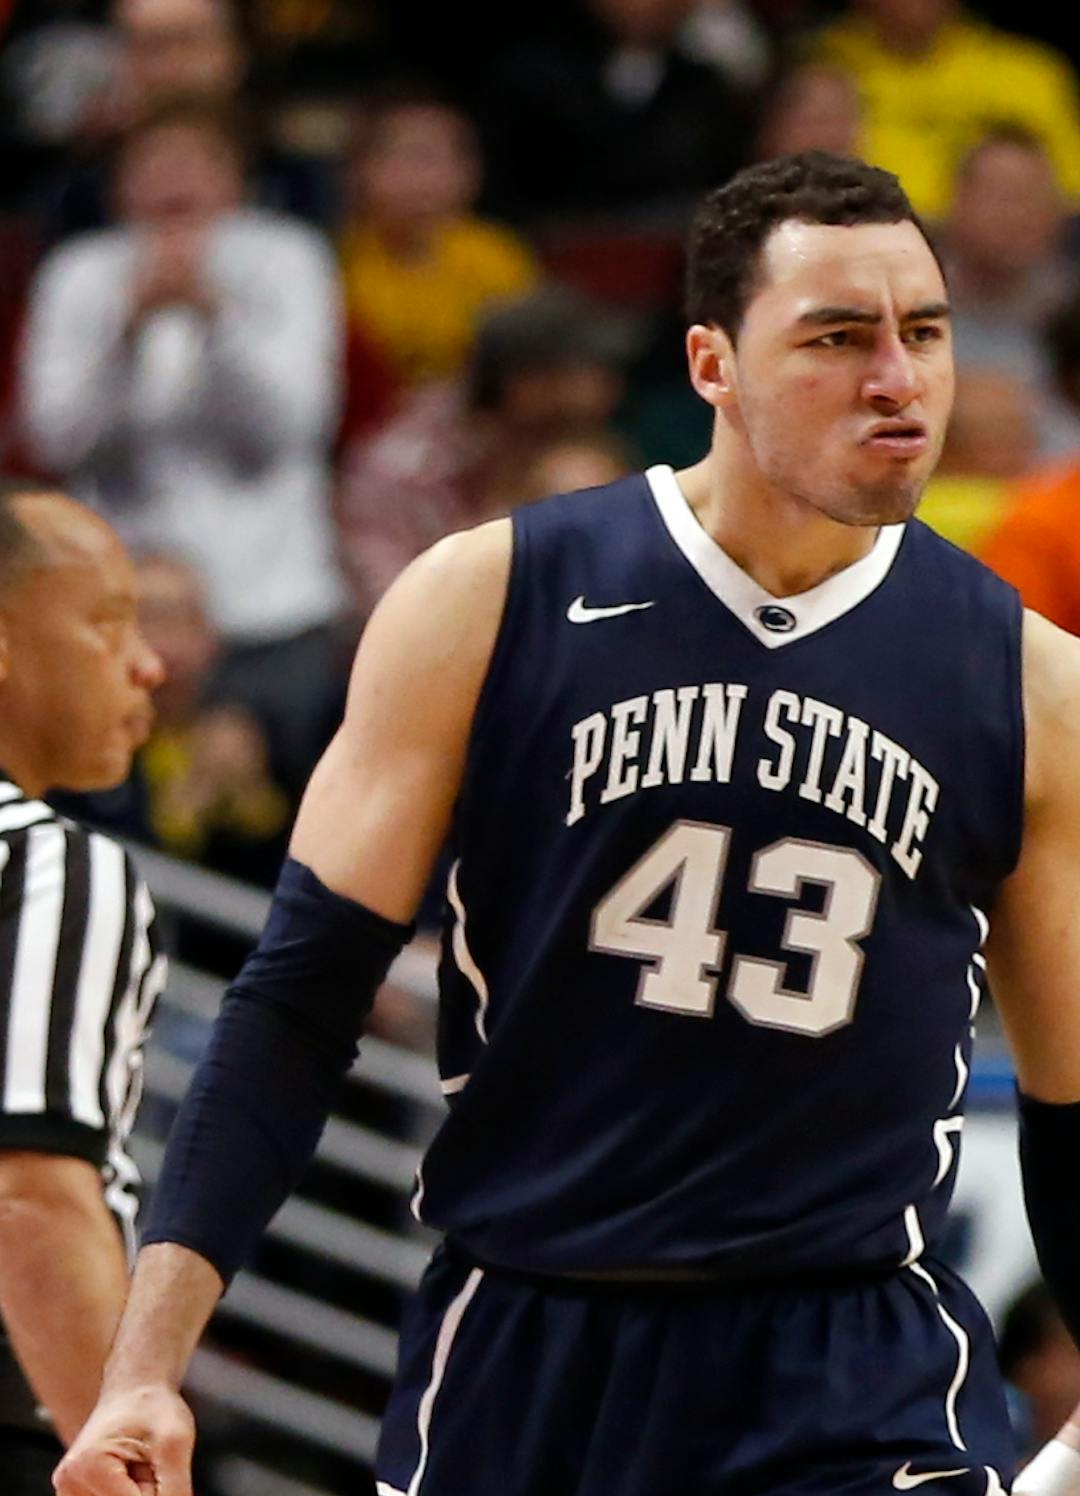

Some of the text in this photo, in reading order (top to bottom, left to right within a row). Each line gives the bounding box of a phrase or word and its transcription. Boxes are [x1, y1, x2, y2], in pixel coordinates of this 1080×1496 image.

[565, 682, 941, 880] PENN STATE
[587, 818, 883, 1038] 43
